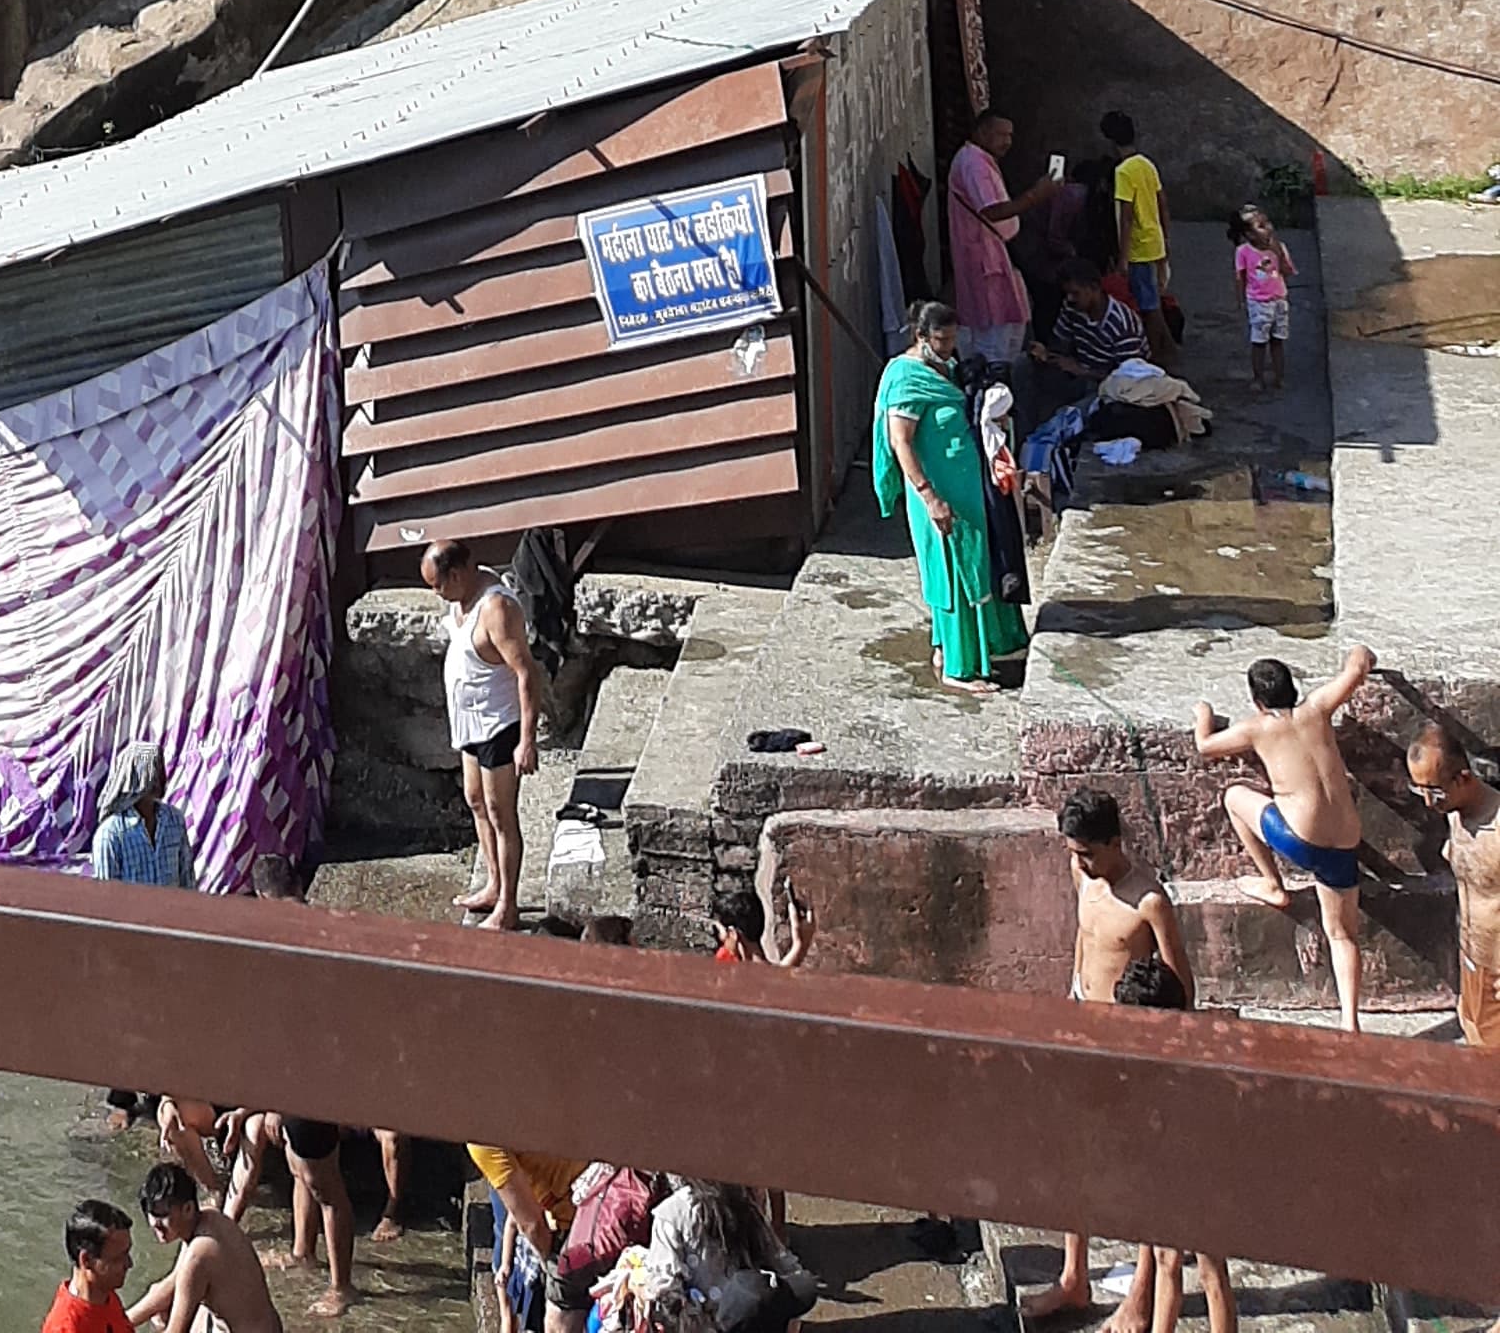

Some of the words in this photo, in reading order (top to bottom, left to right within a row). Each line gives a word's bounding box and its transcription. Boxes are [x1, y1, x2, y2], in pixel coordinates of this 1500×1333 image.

[598, 222, 646, 263] मर्दाना
[644, 220, 674, 253] घाट
[672, 215, 694, 249] पर
[650, 259, 695, 298] बैठना
[691, 256, 724, 290] मना
